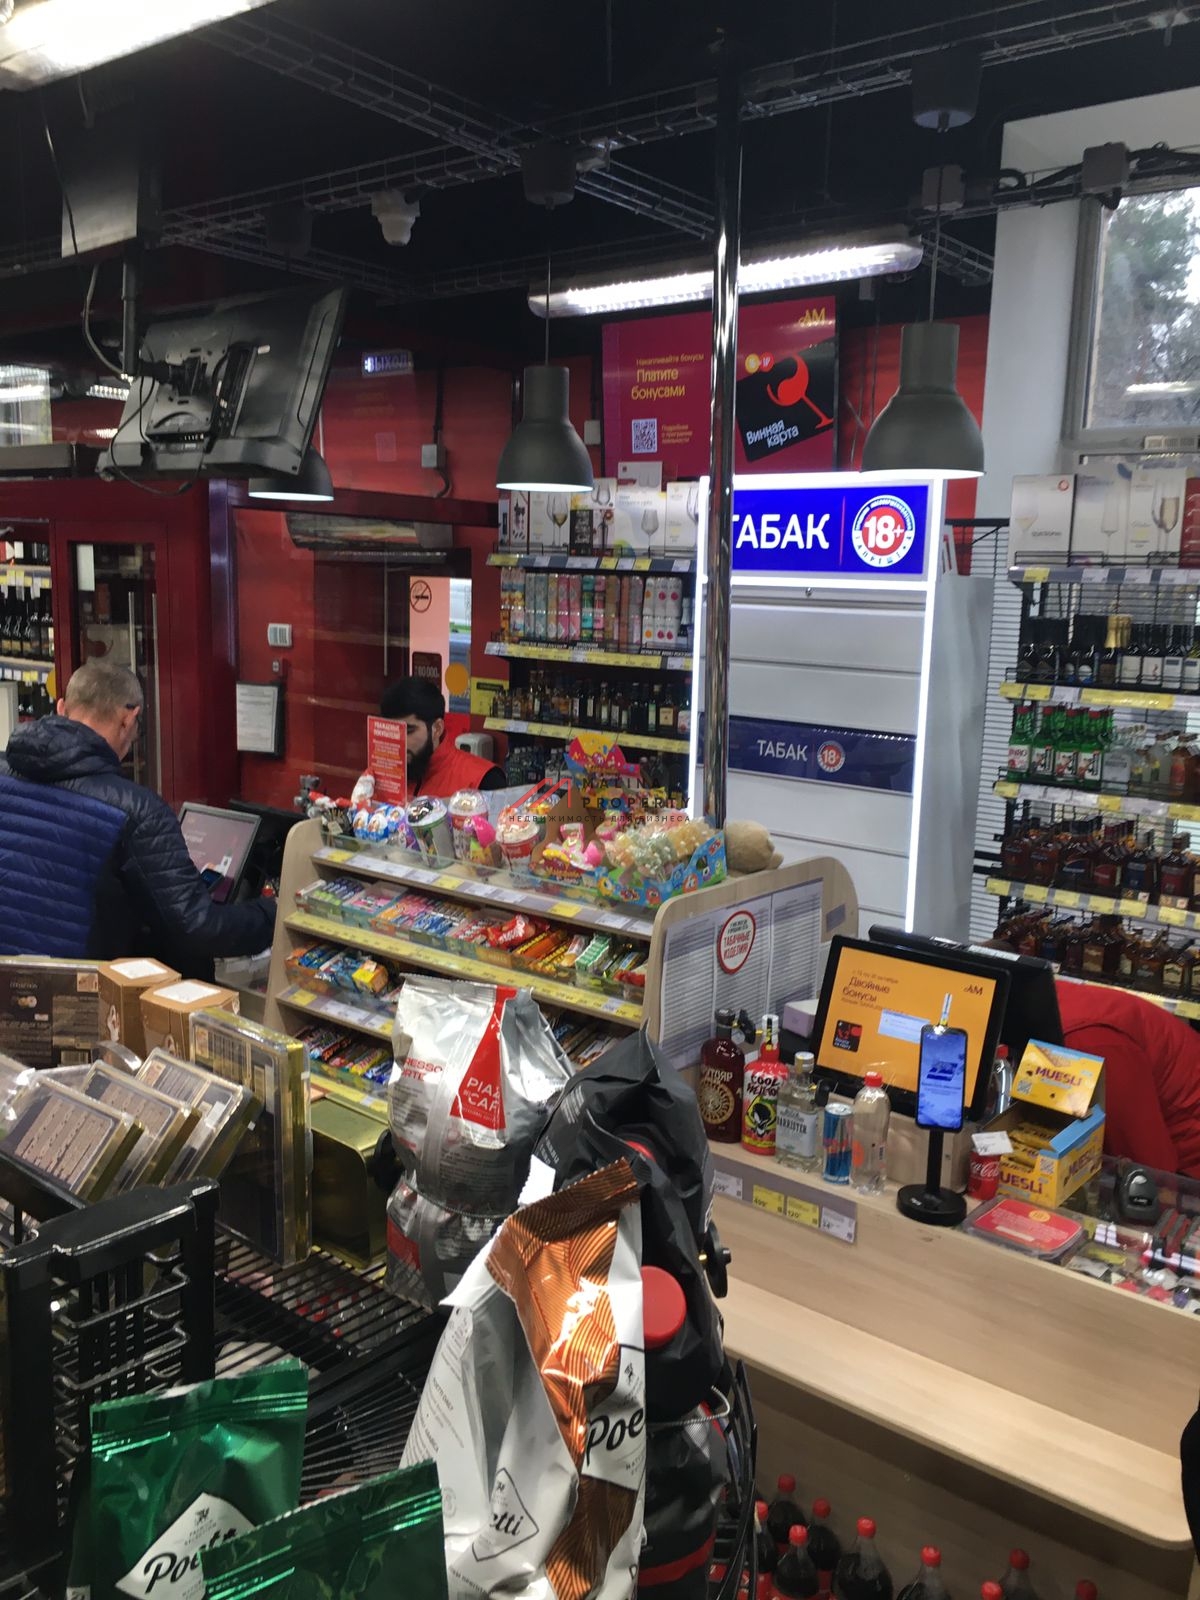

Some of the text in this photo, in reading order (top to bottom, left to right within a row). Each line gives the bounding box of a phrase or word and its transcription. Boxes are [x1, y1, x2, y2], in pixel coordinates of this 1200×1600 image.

[367, 354, 408, 373] ВЫХОД
[636, 368, 679, 382] Платите
[631, 385, 686, 401] бонусами
[746, 420, 785, 445] Винная
[767, 425, 799, 449] карта
[863, 515, 905, 550] 18+
[757, 739, 807, 762] ТАБАК
[402, 1068, 426, 1082] ORTE
[406, 1057, 444, 1073] RESSO
[467, 1093, 500, 1112] CAF
[1000, 1171, 1043, 1195] UESLi
[586, 1407, 645, 1467] Poe
